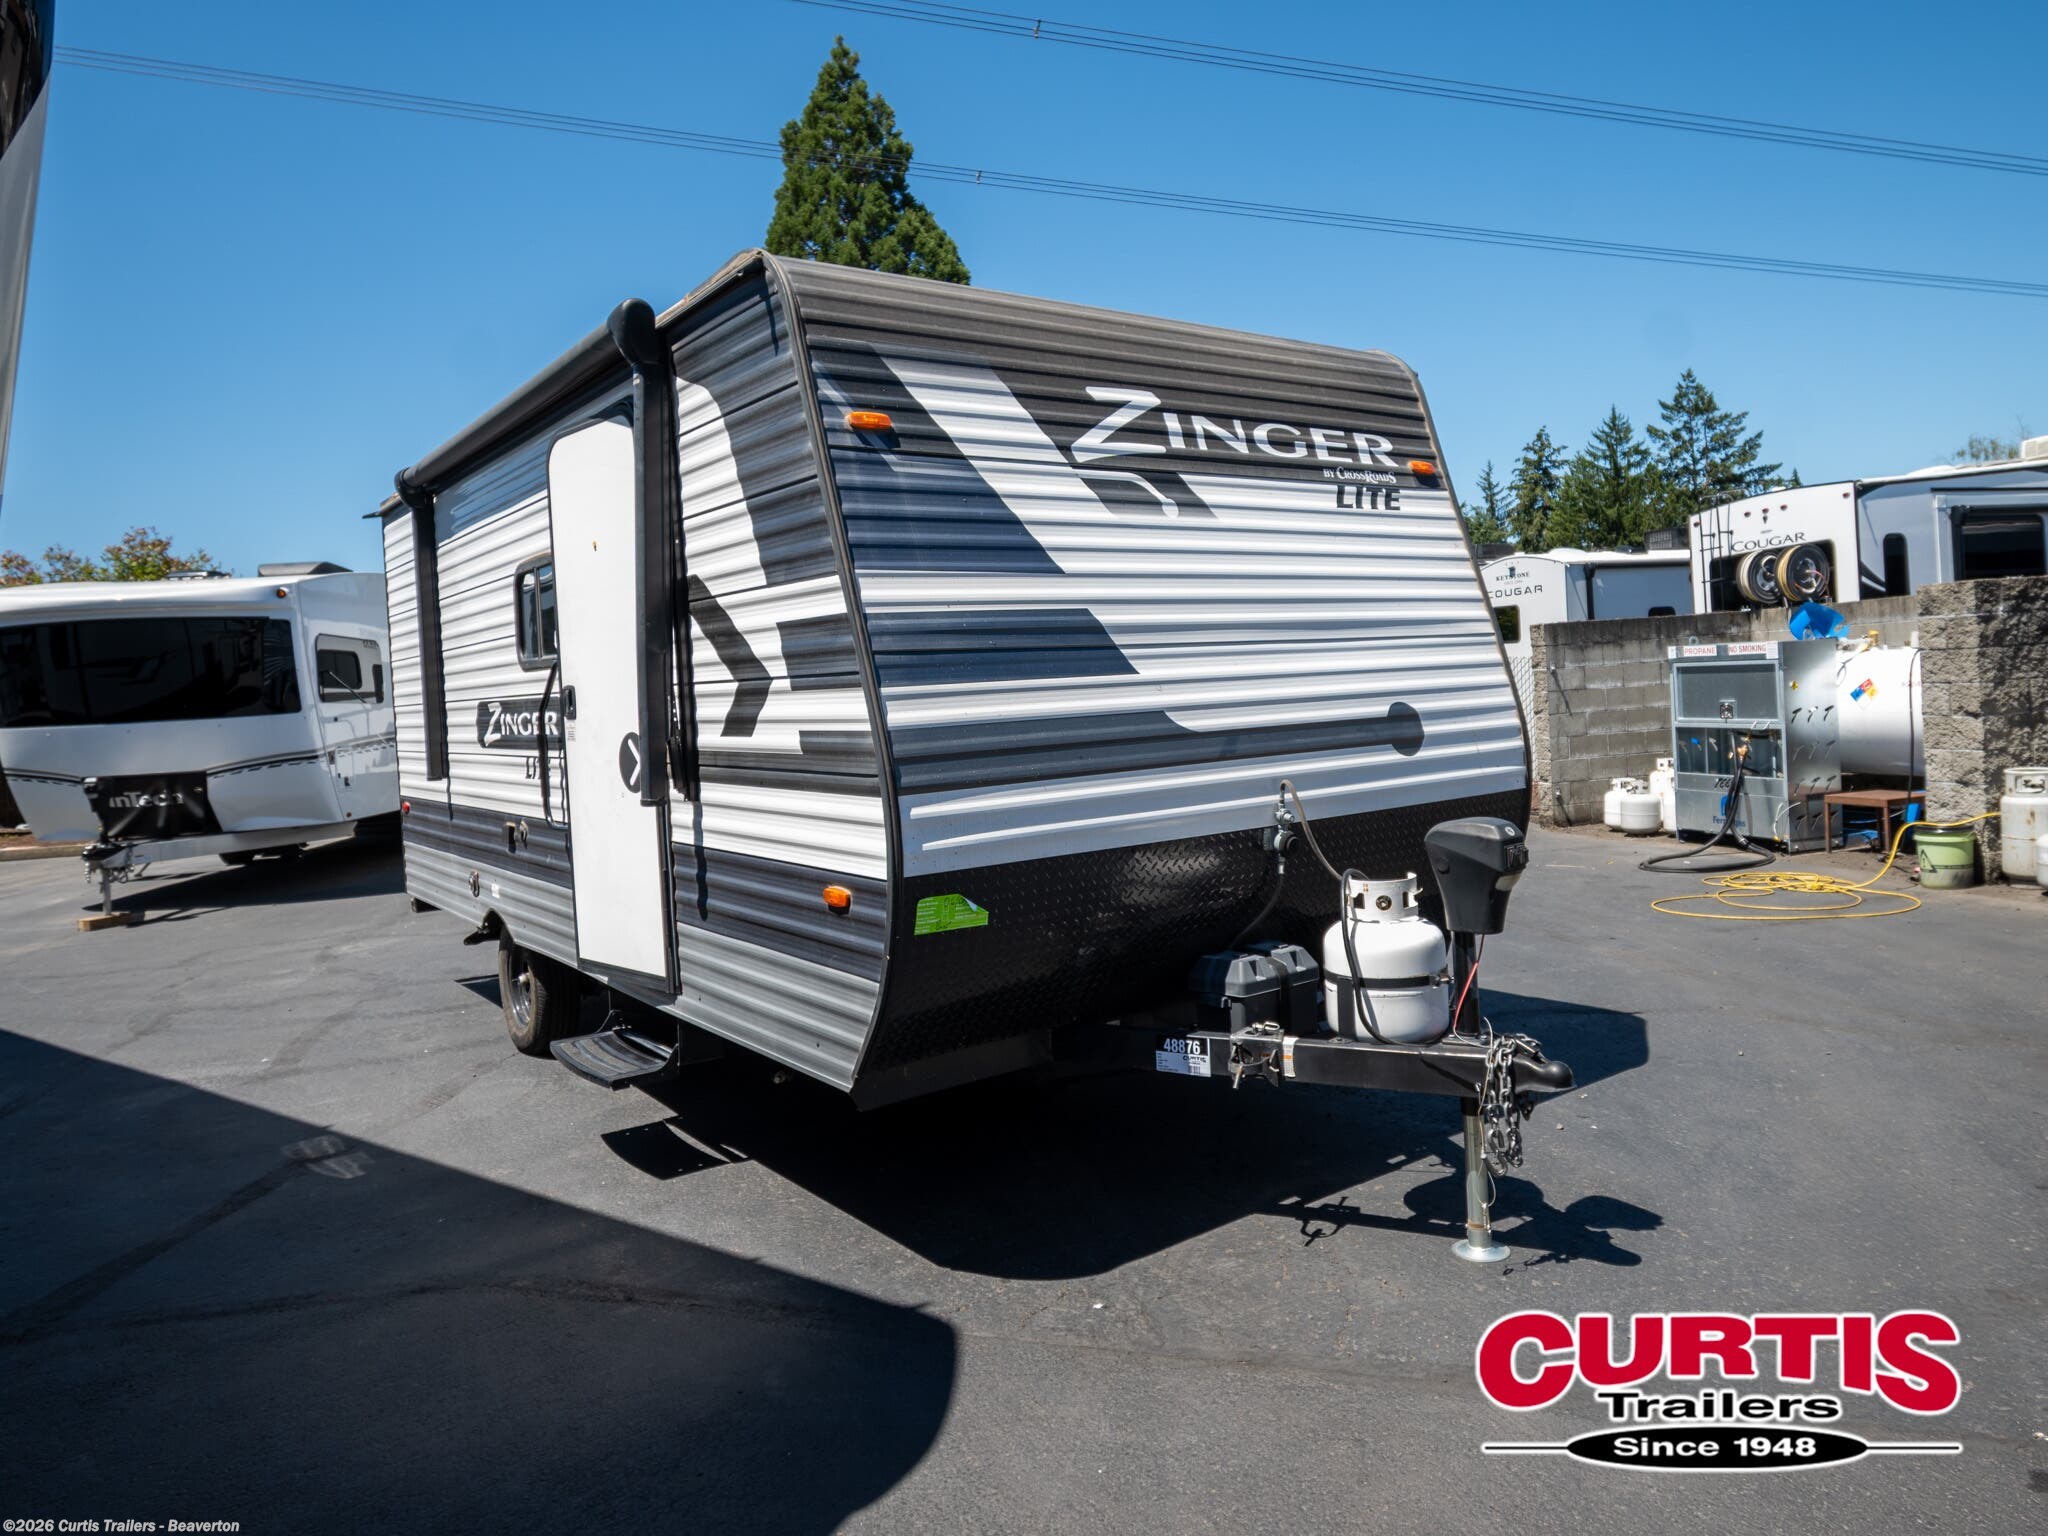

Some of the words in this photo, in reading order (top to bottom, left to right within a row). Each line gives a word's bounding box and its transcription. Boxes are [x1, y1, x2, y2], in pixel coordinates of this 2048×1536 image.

[1070, 386, 1399, 467] ZINGER
[1323, 468, 1337, 479] BY
[1337, 484, 1400, 510] LITE
[1732, 532, 1807, 552] COUGAR
[1684, 646, 1716, 655] PROPANE
[1729, 645, 1737, 654] NO
[1739, 644, 1767, 653] SMOKING
[1163, 1038, 1201, 1055] 48876
